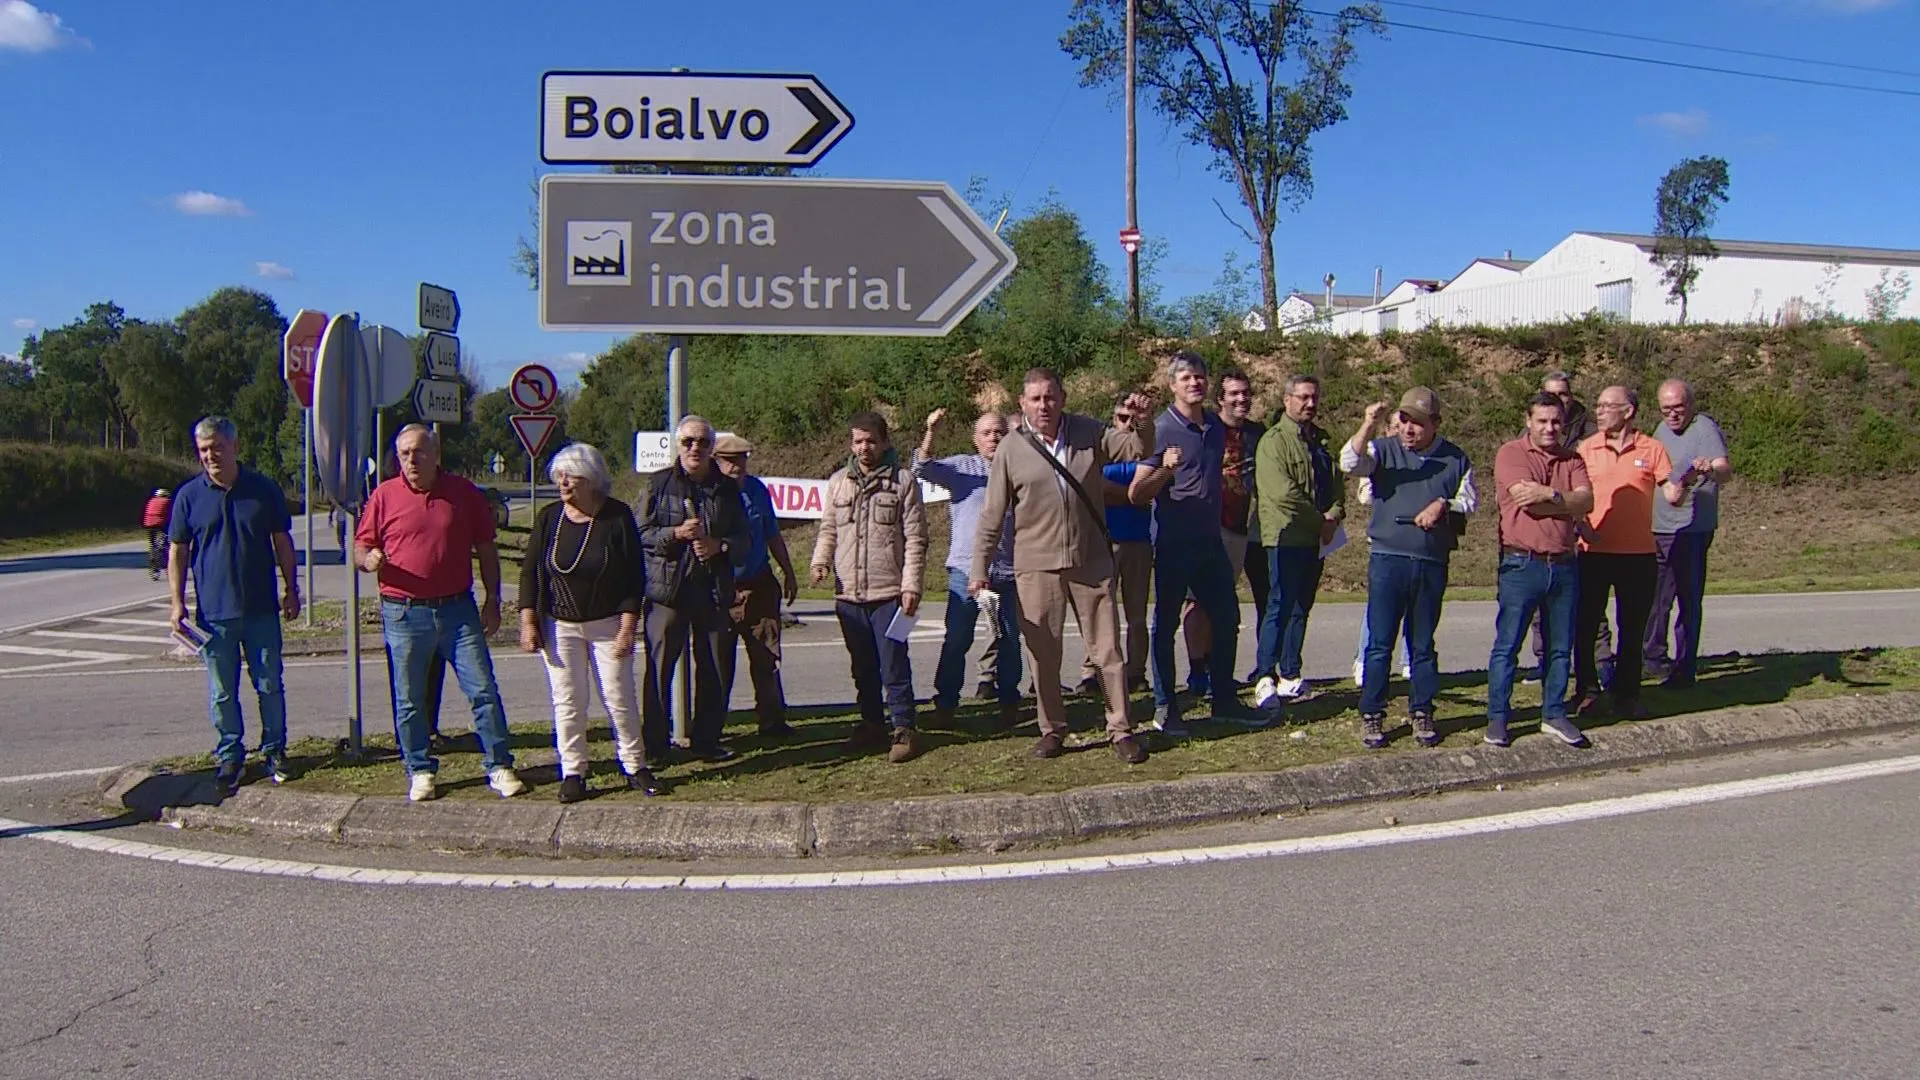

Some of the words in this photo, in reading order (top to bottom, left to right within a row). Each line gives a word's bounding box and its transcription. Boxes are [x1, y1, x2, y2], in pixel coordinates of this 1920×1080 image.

[565, 96, 770, 141] Boialvo
[649, 210, 776, 246] zona
[649, 263, 912, 311] industrial
[424, 295, 451, 321] Aveiro
[290, 345, 314, 376] ST
[428, 390, 458, 413] Anadia
[640, 450, 665, 459] Centro
[767, 483, 823, 512] NDA
